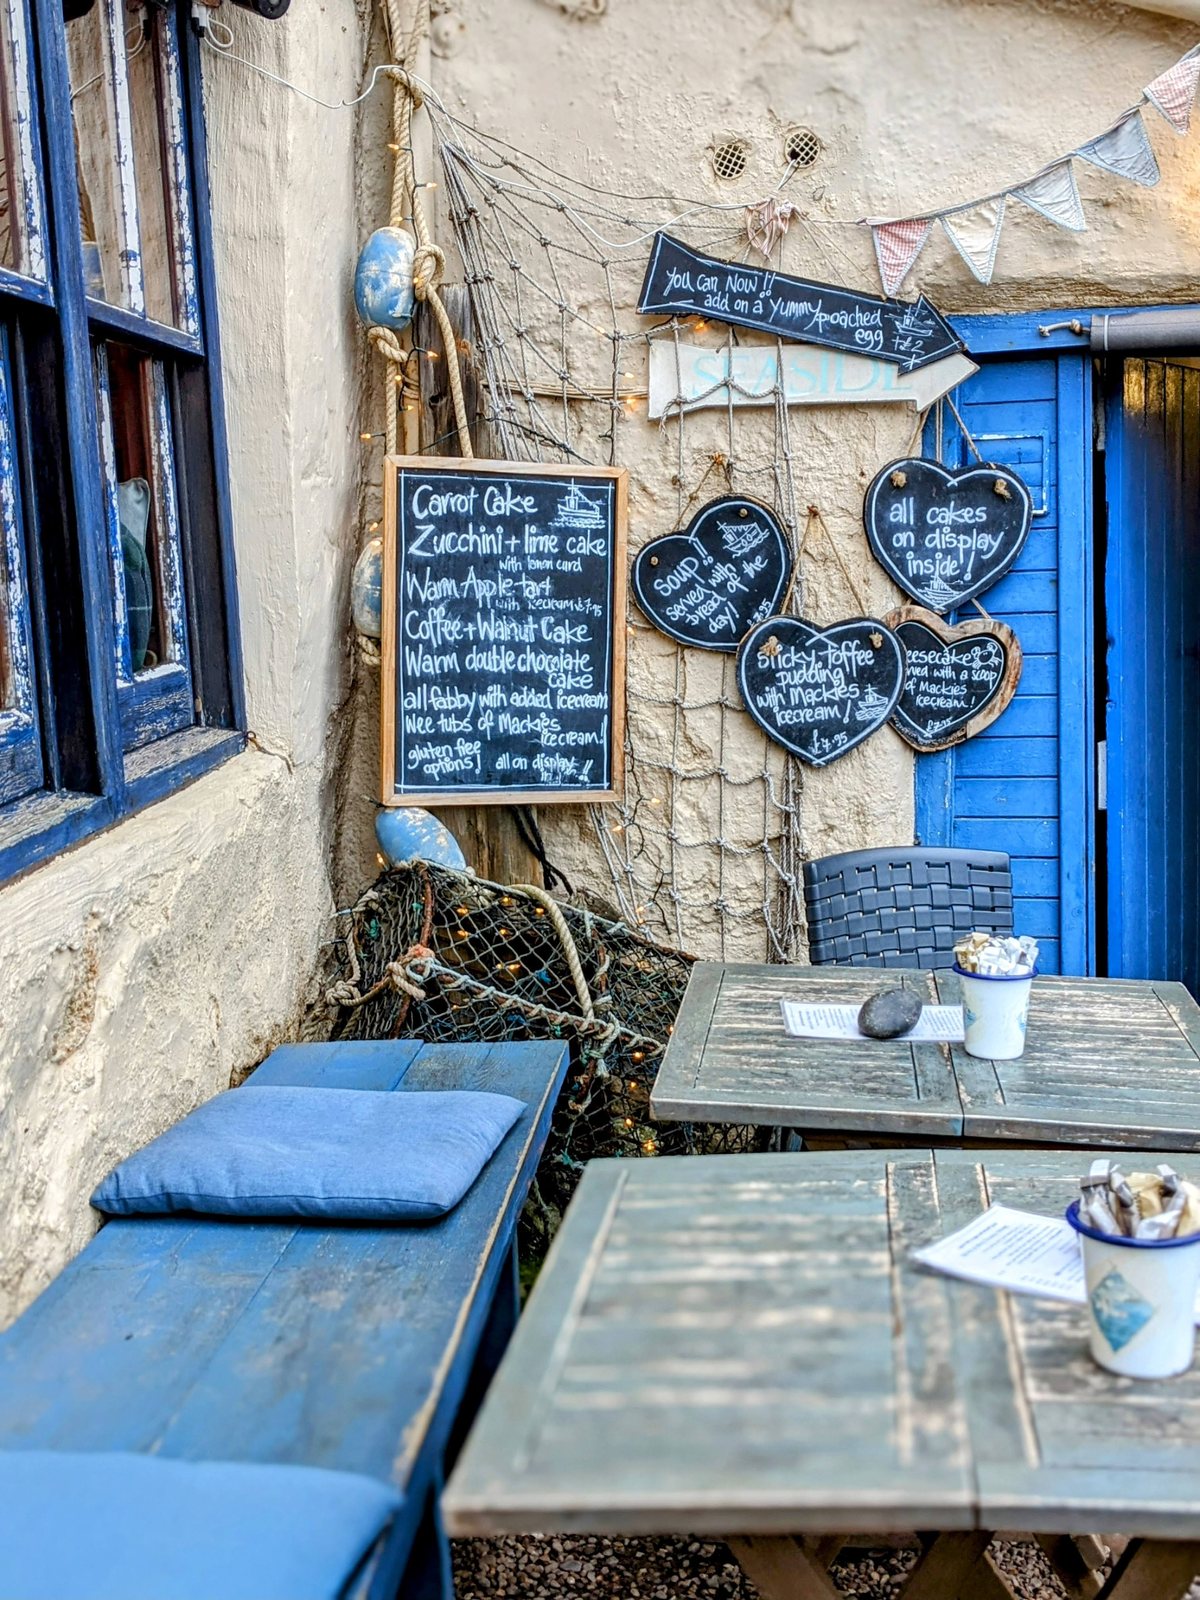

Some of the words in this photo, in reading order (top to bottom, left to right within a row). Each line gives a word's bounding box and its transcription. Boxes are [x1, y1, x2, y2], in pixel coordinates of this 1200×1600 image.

[697, 269, 718, 292] can
[703, 292, 729, 312] add
[734, 299, 749, 315] on
[753, 299, 763, 315] a
[815, 305, 882, 335] poached
[855, 327, 884, 352] egg
[412, 484, 479, 520] Carrot
[484, 482, 538, 517] Cake
[889, 496, 914, 526] all
[926, 500, 987, 525] cakes
[408, 522, 503, 557] Zucchini
[505, 534, 521, 552] +
[524, 524, 559, 554] lime
[566, 529, 607, 556] cake
[892, 531, 915, 548] on
[924, 526, 1004, 564] display
[500, 555, 522, 573] with
[556, 557, 583, 573] curd
[906, 550, 975, 581] inside!
[406, 567, 459, 602] Warm
[460, 565, 514, 609] Apple
[514, 572, 551, 600] tart
[666, 584, 711, 621] served
[708, 562, 737, 587] with
[685, 591, 727, 626] bread
[727, 572, 749, 593] of
[742, 554, 769, 579] the
[495, 597, 520, 611] with
[709, 601, 740, 634] day!
[405, 606, 464, 648] Coffee
[463, 622, 477, 640] +
[477, 609, 539, 643] Walnut
[540, 615, 592, 644] Cake
[405, 644, 460, 677] Warm
[465, 644, 516, 674] double
[517, 646, 593, 674] chocolate
[906, 649, 972, 666] eesecake
[549, 671, 594, 690] cake
[775, 662, 844, 693] pudding
[905, 677, 917, 695] of
[919, 680, 967, 695] Mackies
[933, 665, 956, 680] with
[960, 670, 968, 680] a
[971, 669, 997, 690] scoop
[403, 684, 428, 711] all
[428, 686, 477, 717] fabby
[479, 685, 507, 709] with
[510, 687, 553, 709] added
[556, 690, 608, 710] icecream
[756, 686, 785, 708] with
[790, 680, 860, 707] Mackies
[405, 714, 435, 735] Wee
[437, 714, 473, 733] tubs
[478, 709, 493, 740] of
[499, 712, 561, 735] Mackies
[407, 741, 453, 770] gluten
[454, 738, 481, 756] free
[423, 754, 481, 781] options!
[495, 752, 510, 769] all
[512, 757, 527, 770] on
